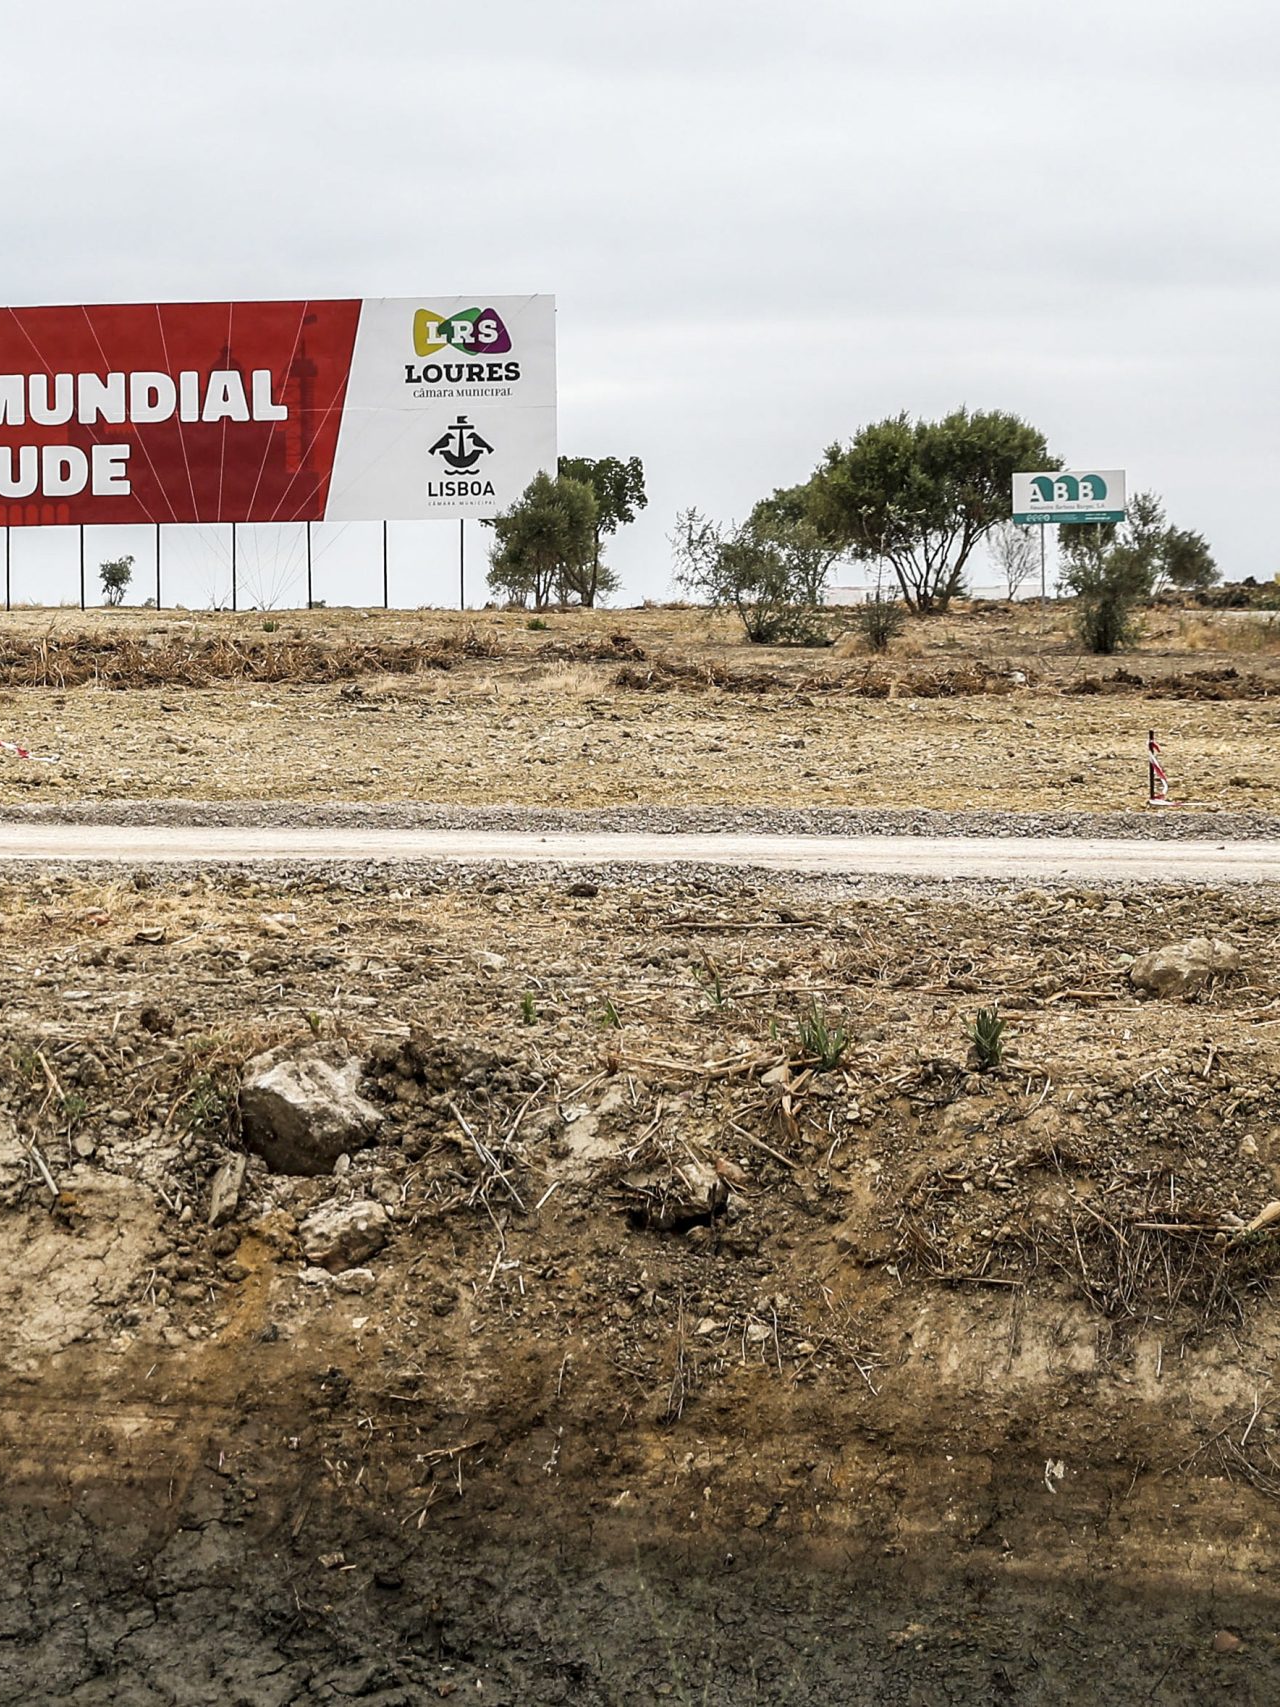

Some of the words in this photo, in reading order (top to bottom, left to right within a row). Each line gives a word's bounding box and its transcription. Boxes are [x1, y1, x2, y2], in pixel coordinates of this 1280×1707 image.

[426, 319, 499, 344] LRS
[404, 361, 521, 383] LOURES
[427, 481, 496, 497] LISBOA
